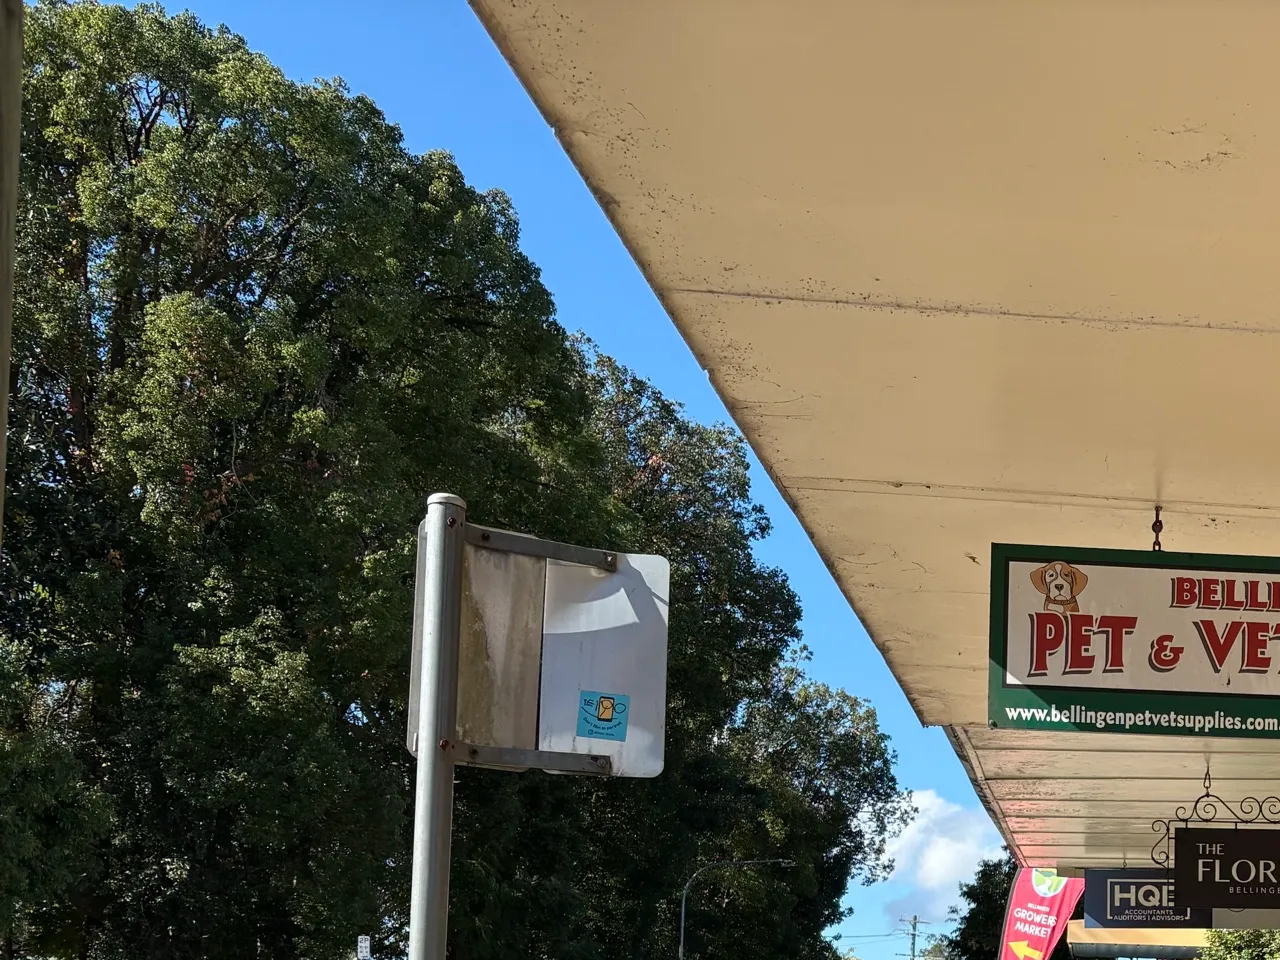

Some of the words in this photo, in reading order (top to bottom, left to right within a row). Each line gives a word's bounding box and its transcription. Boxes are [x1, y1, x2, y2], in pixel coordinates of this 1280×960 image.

[1028, 611, 1138, 677] PET
[1148, 634, 1184, 673] &
[1196, 843, 1225, 855] THE
[1013, 907, 1057, 927] GROWERS
[1015, 922, 1051, 938] MARKET
